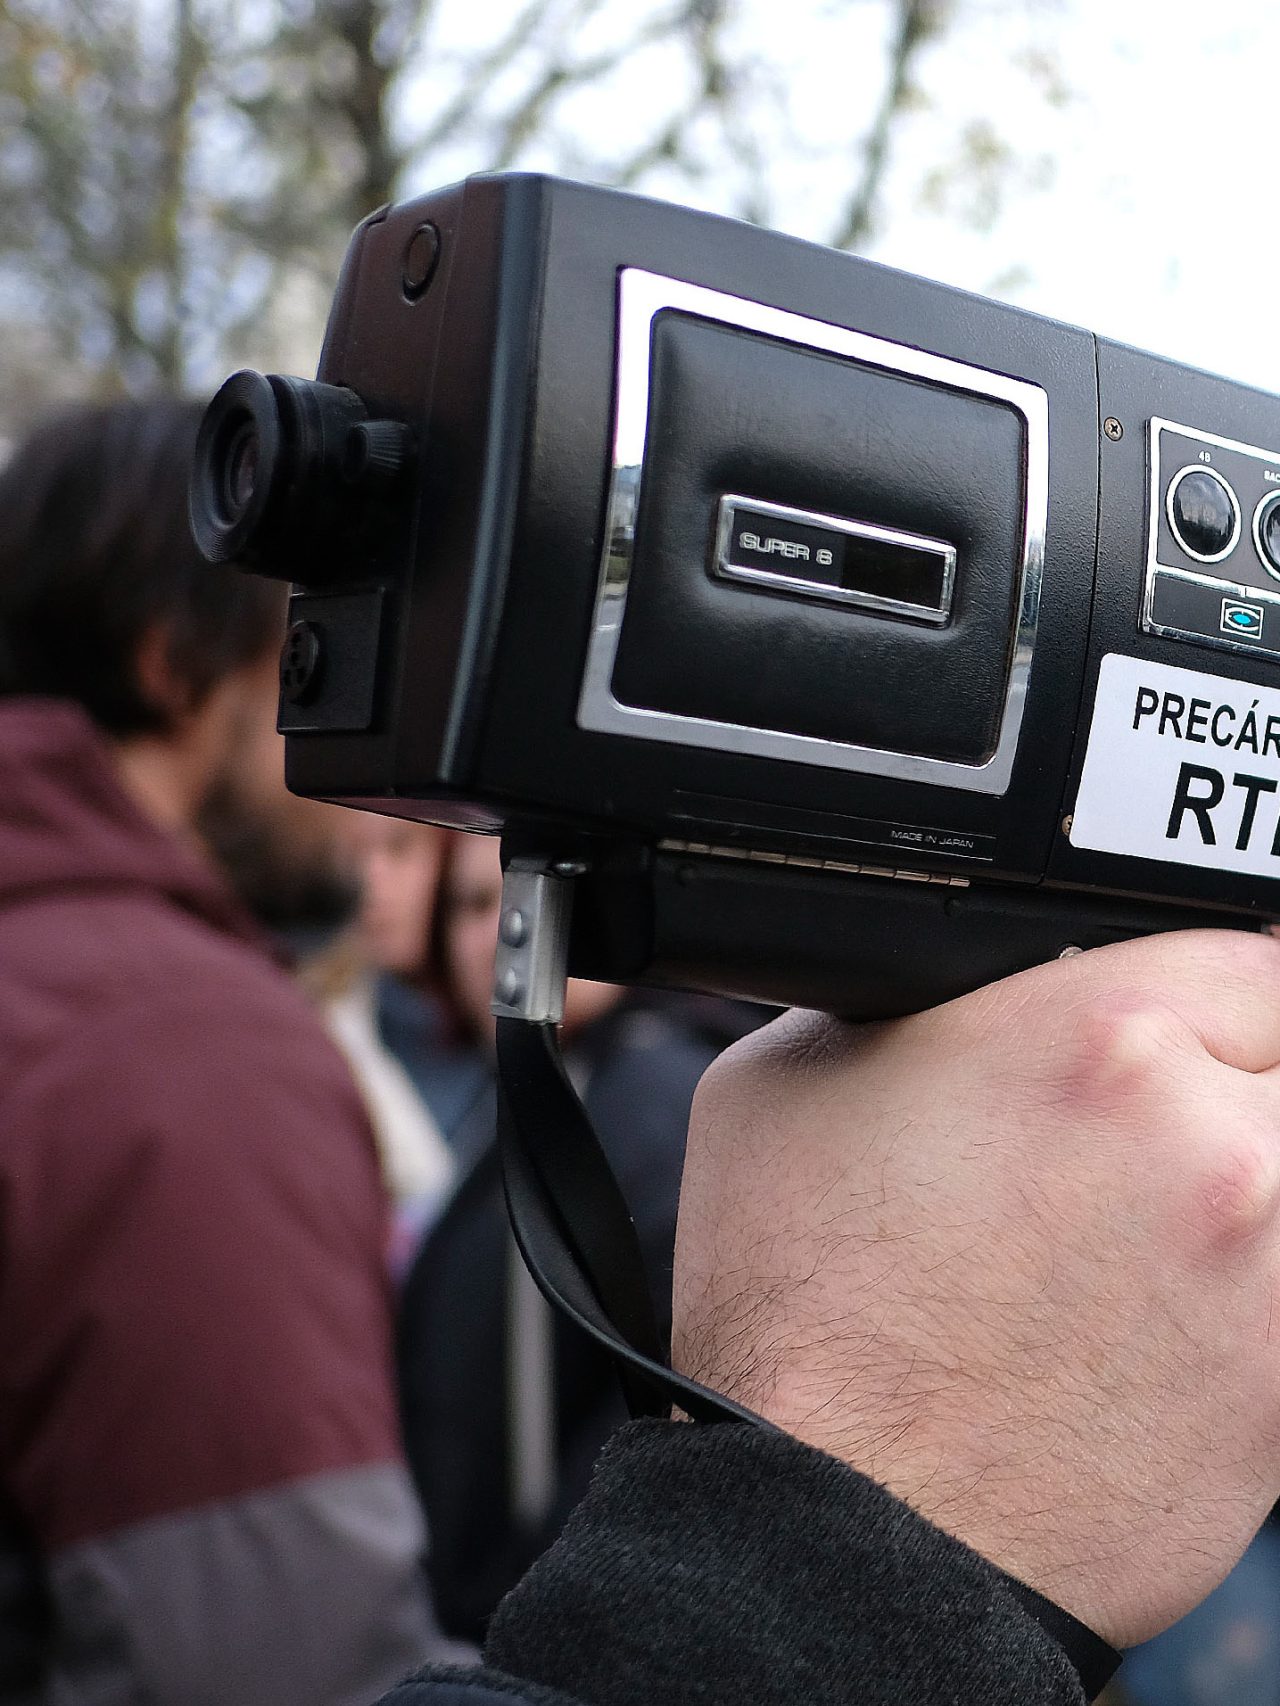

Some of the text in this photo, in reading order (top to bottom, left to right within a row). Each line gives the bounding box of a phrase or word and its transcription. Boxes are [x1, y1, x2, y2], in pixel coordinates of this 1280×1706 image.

[739, 532, 832, 565] SUPER 8
[891, 830, 974, 849] MADE IN JAPAN
